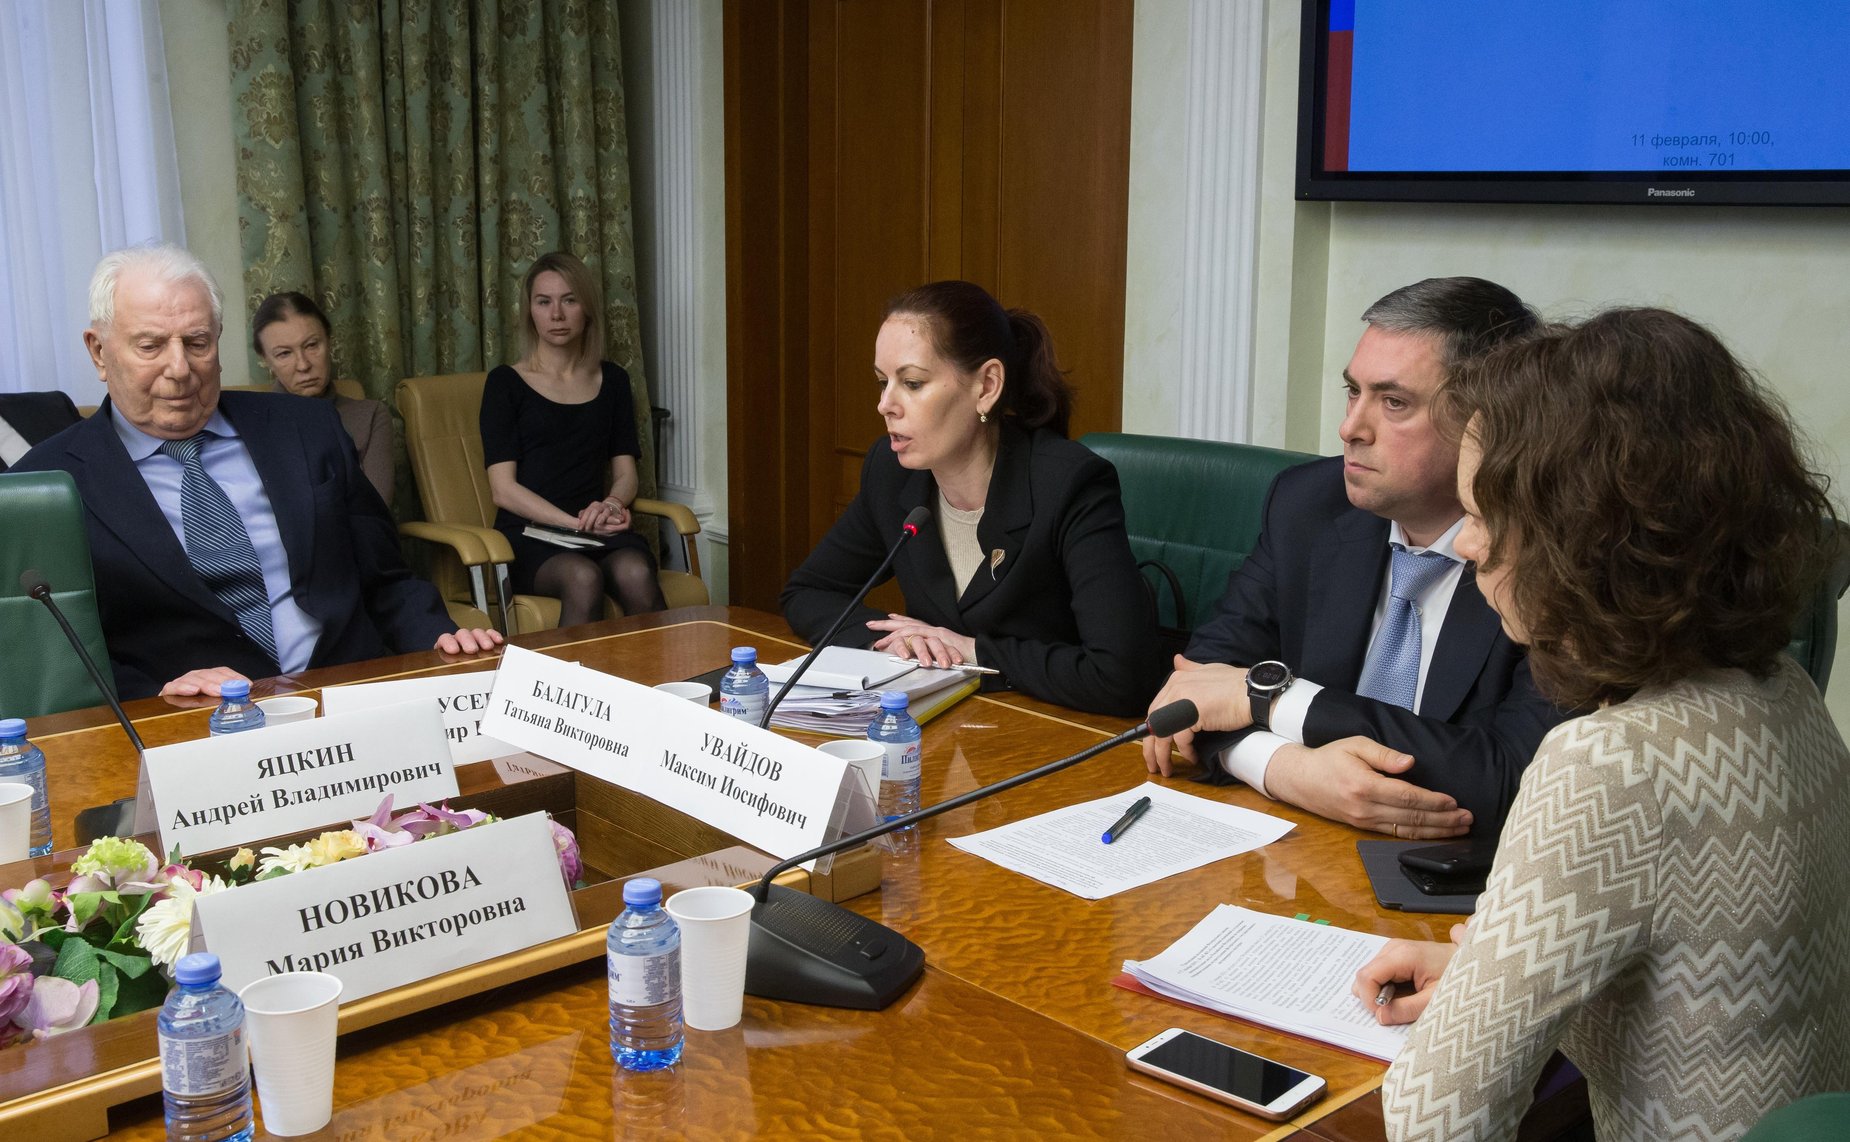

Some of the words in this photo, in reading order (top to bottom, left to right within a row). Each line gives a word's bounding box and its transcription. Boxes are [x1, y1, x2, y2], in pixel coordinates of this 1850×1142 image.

[1631, 134, 1645, 147] 11
[1651, 133, 1721, 149] февраля,
[1729, 131, 1774, 147] 10:00,
[1663, 156, 1701, 167] комн.
[1709, 153, 1735, 166] 701
[1647, 188, 1695, 197] Panasonic
[532, 680, 612, 721] БАЛАГУЛА
[503, 699, 552, 730] Татьяна
[554, 718, 629, 758] Викторовна
[257, 742, 356, 780] ЯЦКИН
[700, 732, 783, 782] УВАЙДОВ
[171, 795, 265, 830] Андрей
[271, 762, 442, 809] Владимирович
[660, 750, 717, 790] Максим
[719, 775, 808, 829] Иосифович
[298, 865, 482, 933] НОВИКОВА
[265, 942, 364, 975] Мария
[369, 896, 526, 954] Викторовна
